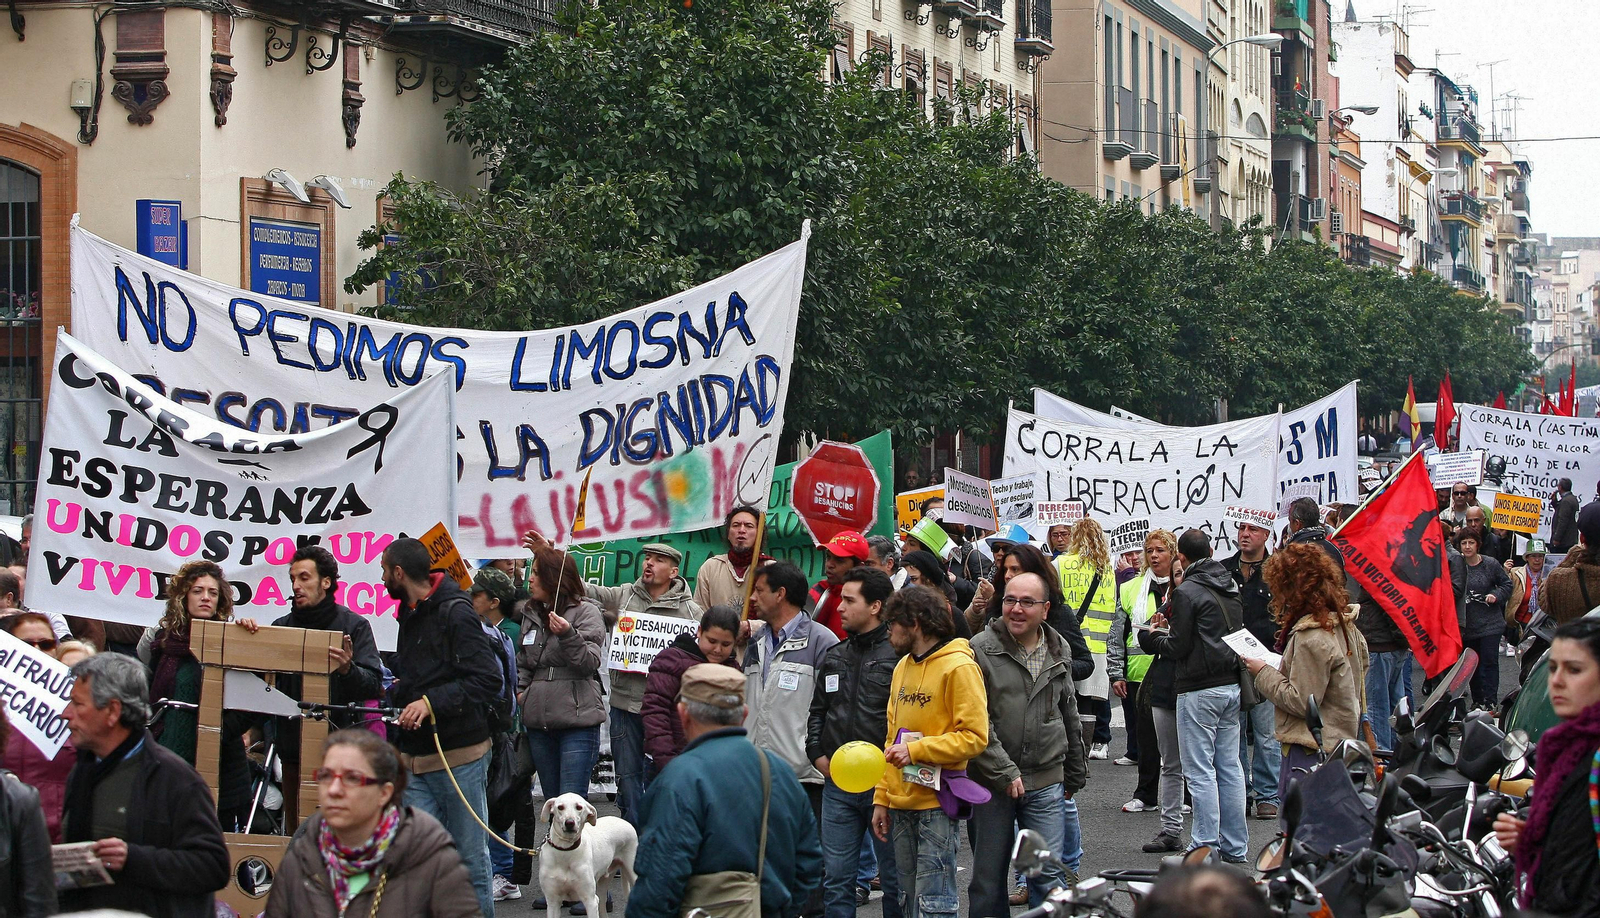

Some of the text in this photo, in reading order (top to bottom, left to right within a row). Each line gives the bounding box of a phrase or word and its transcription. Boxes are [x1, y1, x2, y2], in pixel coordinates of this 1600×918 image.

[154, 236, 177, 253] BAZAR
[114, 265, 756, 392] NO PEDIMOS LIMOSNA
[479, 418, 553, 482] LA
[576, 353, 781, 472] DIGNIDAD
[102, 409, 180, 457] LA
[1018, 418, 1239, 464] CORRALA LA
[1484, 431, 1498, 443] EL
[1532, 439, 1551, 450] DEL
[1556, 444, 1591, 454] ALCOR
[1547, 460, 1560, 470] DE
[1566, 460, 1581, 470] LA
[46, 447, 373, 524] ESPERANZA
[814, 481, 856, 502] STOP
[980, 487, 990, 500] en
[814, 496, 854, 511] DESAHUCIOS
[1038, 503, 1081, 512] DERECHO
[1038, 511, 1082, 520] A TECHO
[46, 498, 234, 563] UNIDOS
[1111, 519, 1149, 538] DERECHO
[1110, 537, 1116, 547] A
[1351, 552, 1368, 569] LA
[1363, 562, 1409, 610] VICTORIA
[1401, 605, 1438, 657] SIEMPRE
[635, 619, 696, 638] DESAHUCIOS
[613, 636, 619, 646] a
